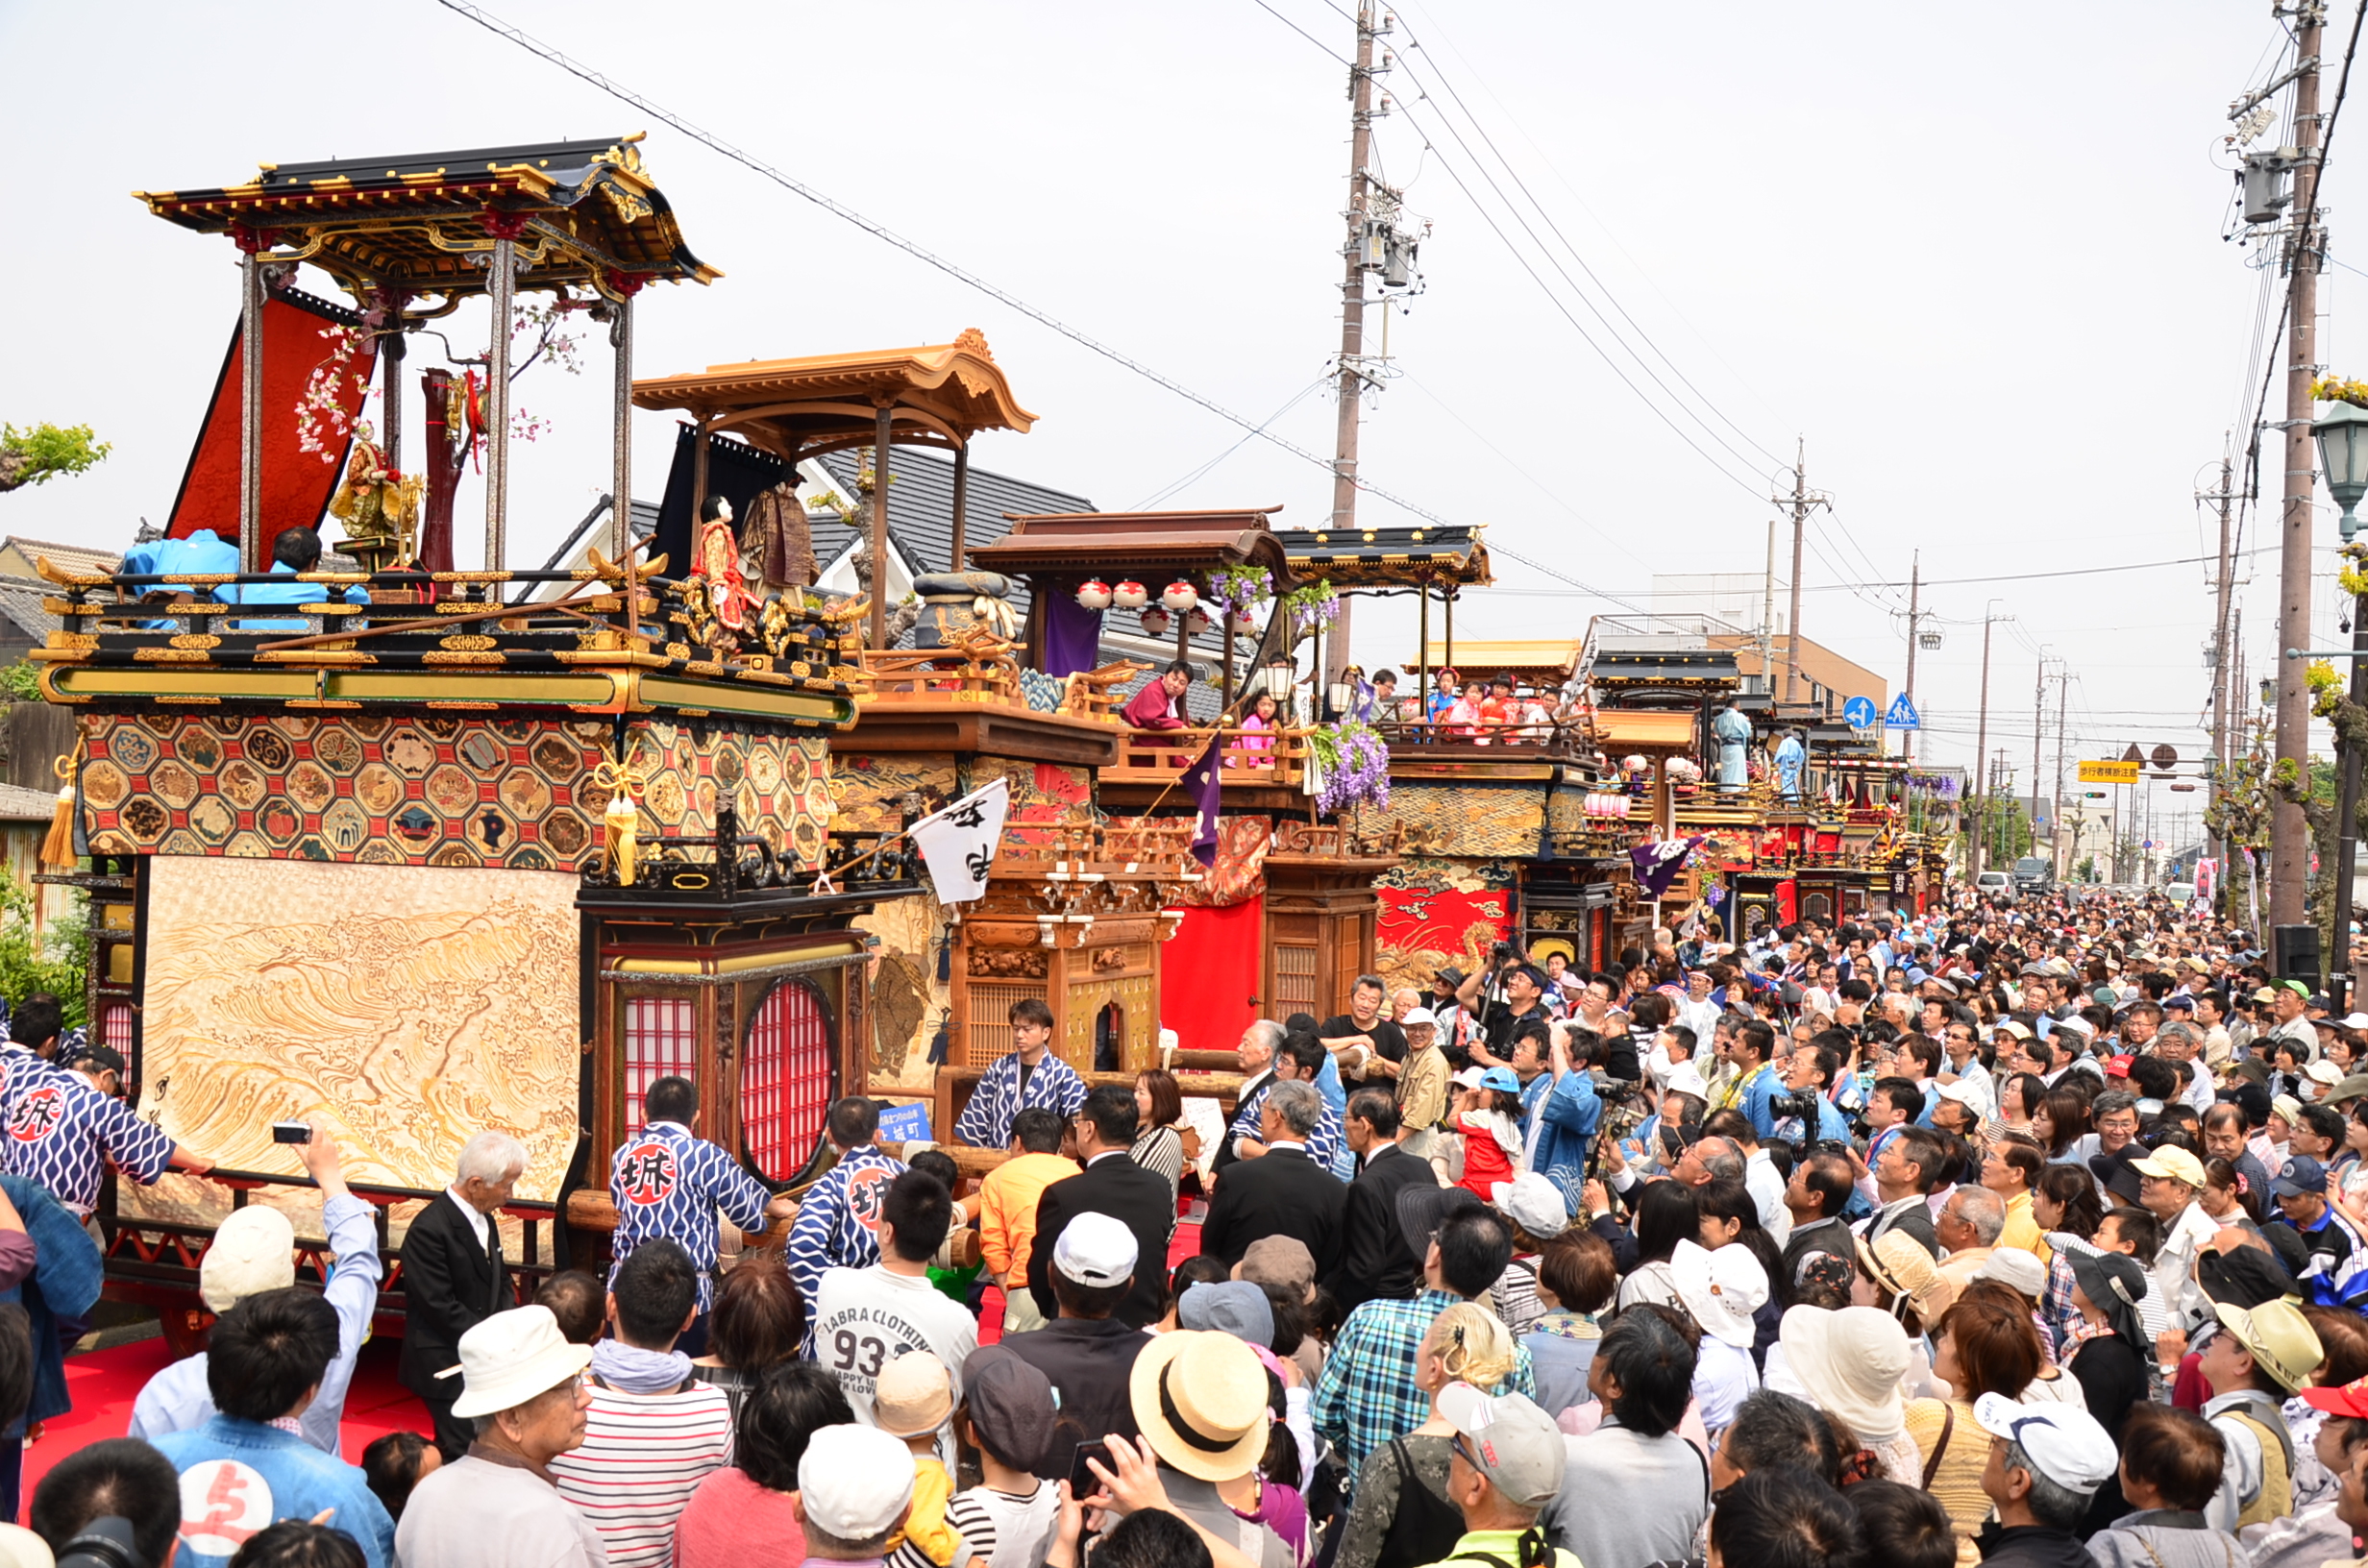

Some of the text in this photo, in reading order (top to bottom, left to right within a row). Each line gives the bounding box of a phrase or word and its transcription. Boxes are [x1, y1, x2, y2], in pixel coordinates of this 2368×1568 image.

[2080, 767, 2137, 777] 歩行者横断注意
[620, 1149, 675, 1195] 城
[823, 1307, 936, 1354] LABRA CLOTHIN
[833, 1329, 886, 1378] 93
